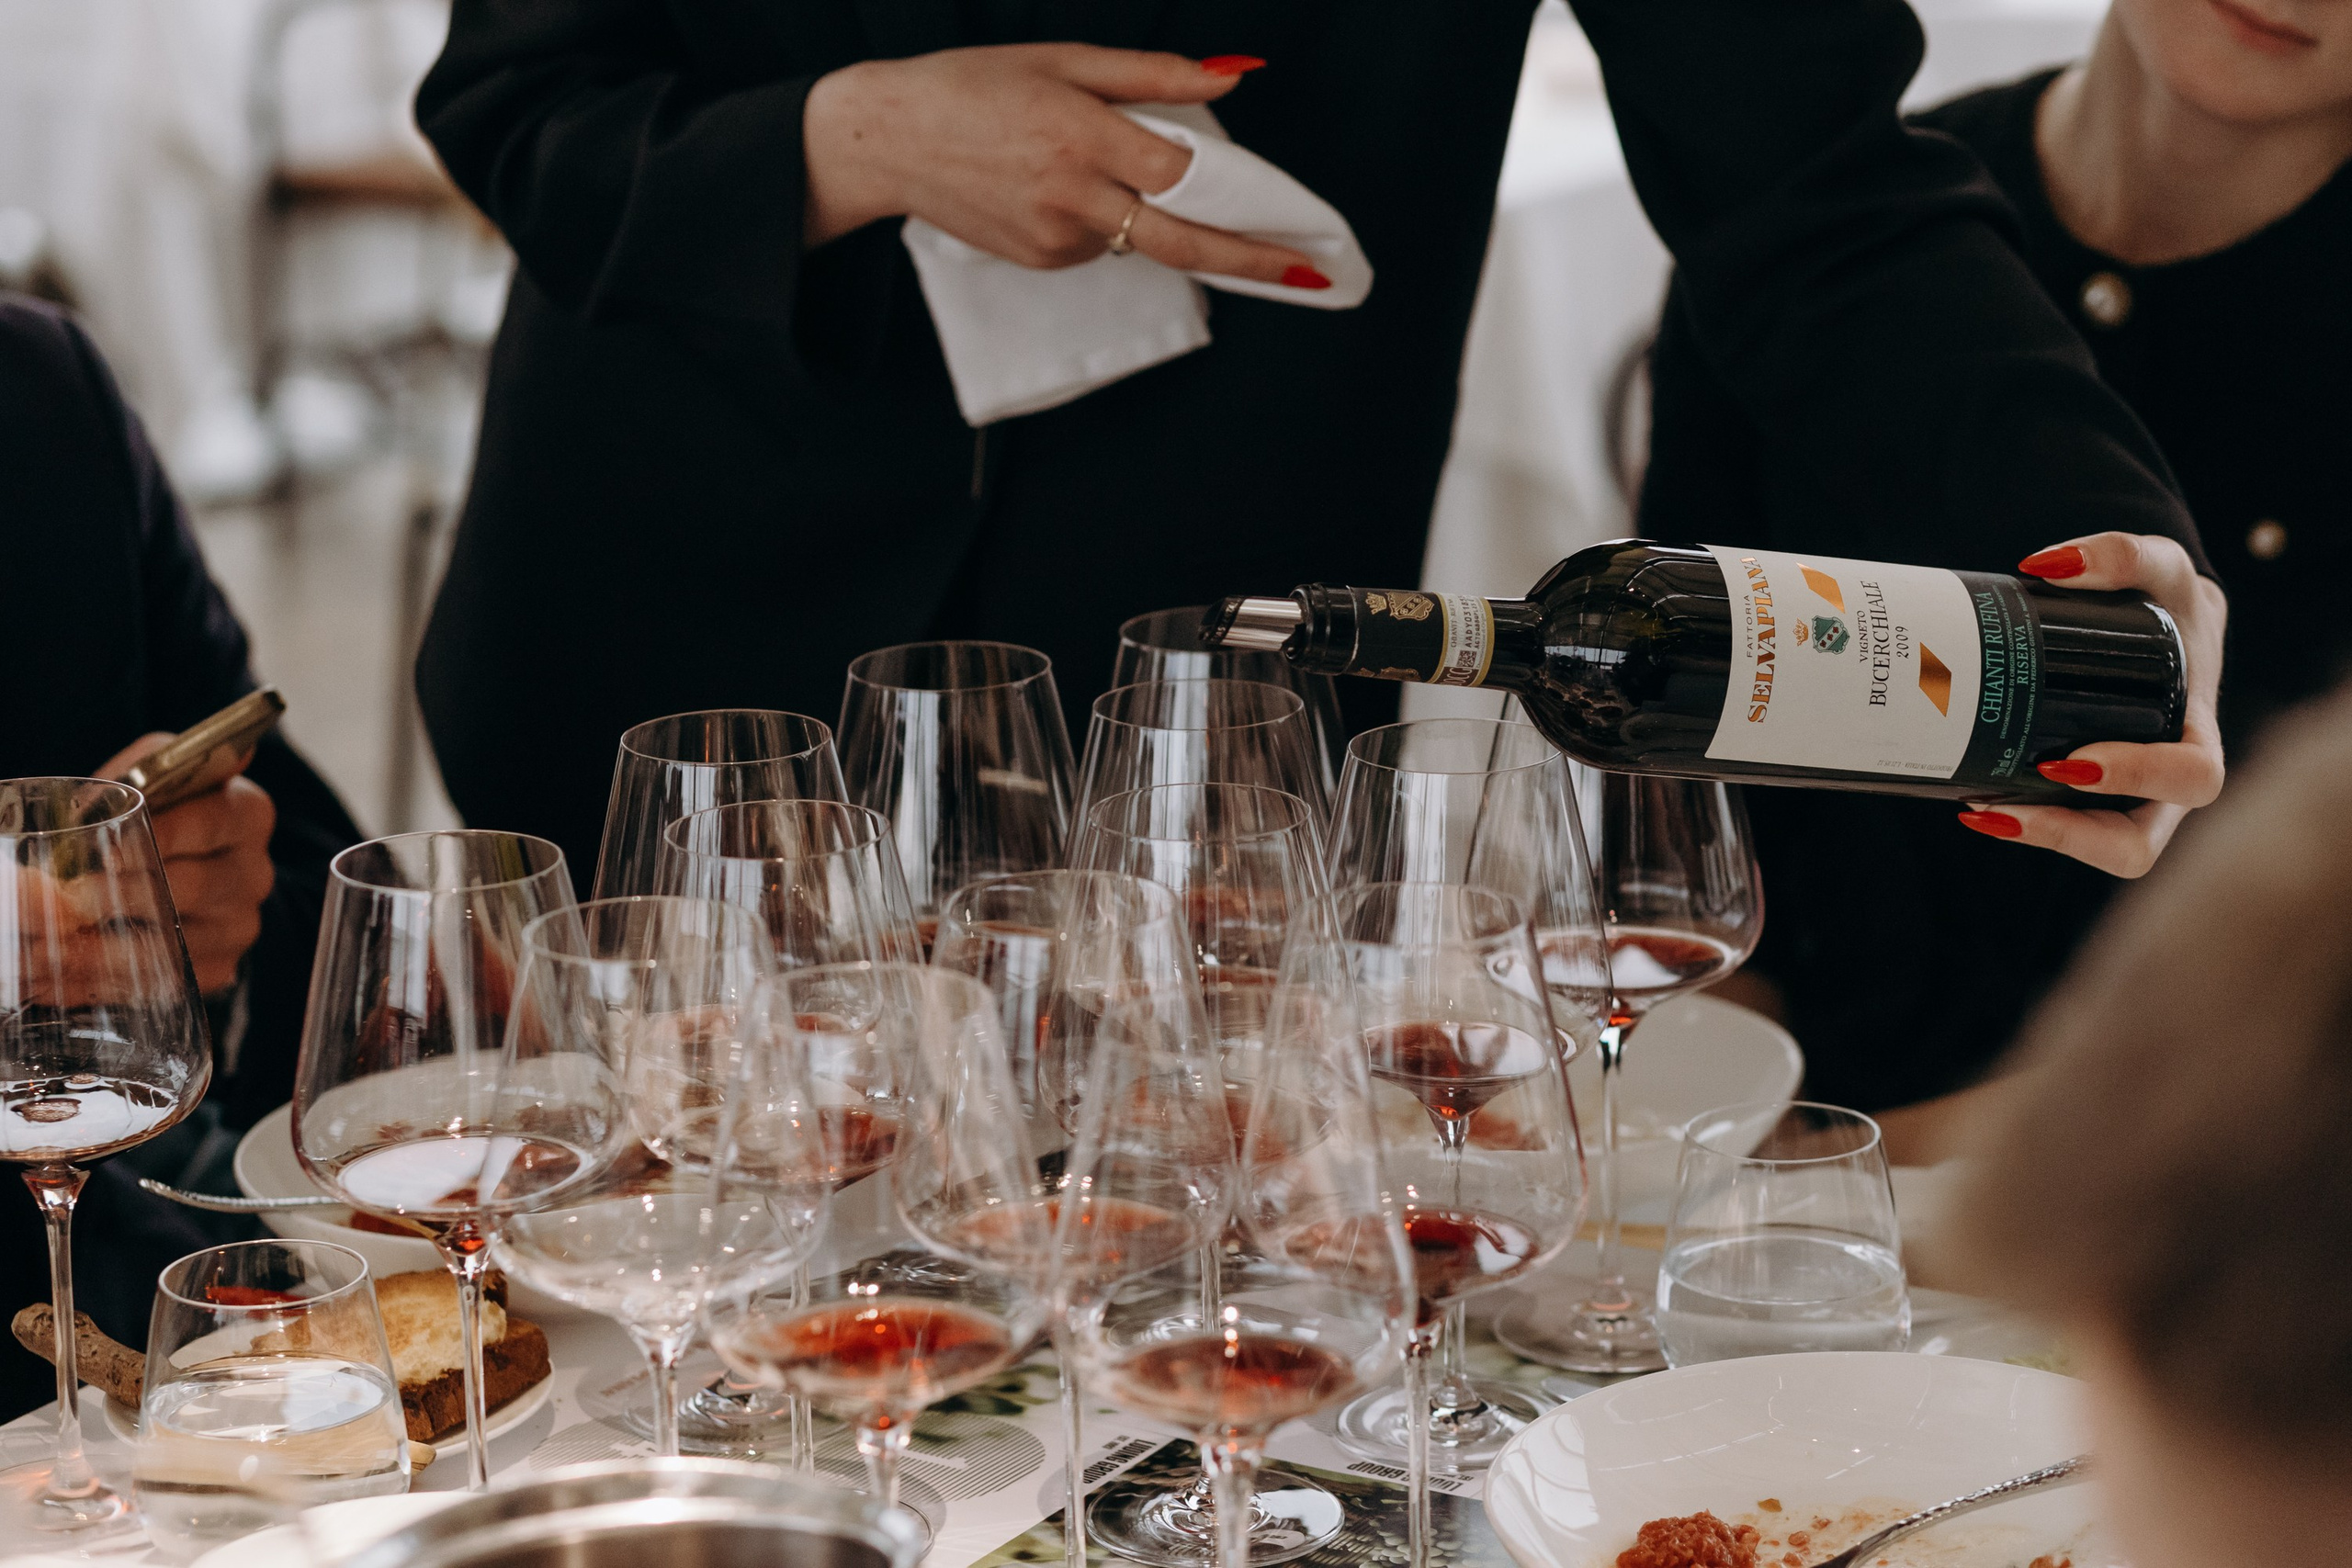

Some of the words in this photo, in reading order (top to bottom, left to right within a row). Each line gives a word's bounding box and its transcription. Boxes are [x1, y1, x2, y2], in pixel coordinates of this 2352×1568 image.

[1739, 556, 1776, 724] SELVAPIANA
[1745, 595, 1754, 658] FATTORIA
[1857, 610, 1869, 663] VIGNETO
[1860, 581, 1891, 706] BUCERCHIALE
[1895, 626, 1909, 659] 2009
[1973, 592, 2004, 645] RUFINA
[2004, 612, 2015, 650] CONTROLLATA
[2026, 619, 2035, 648] GIUNTINI
[2014, 625, 2029, 685] RISERVA
[1981, 649, 2005, 723] CHIANTI
[2030, 682, 2036, 692] DA
[1999, 687, 2015, 739] DENOMINAZIONE
[2023, 694, 2036, 735] ALL'ORIGINE
[1105, 1438, 1157, 1463] LUDING
[1347, 1461, 1407, 1479] GROUP
